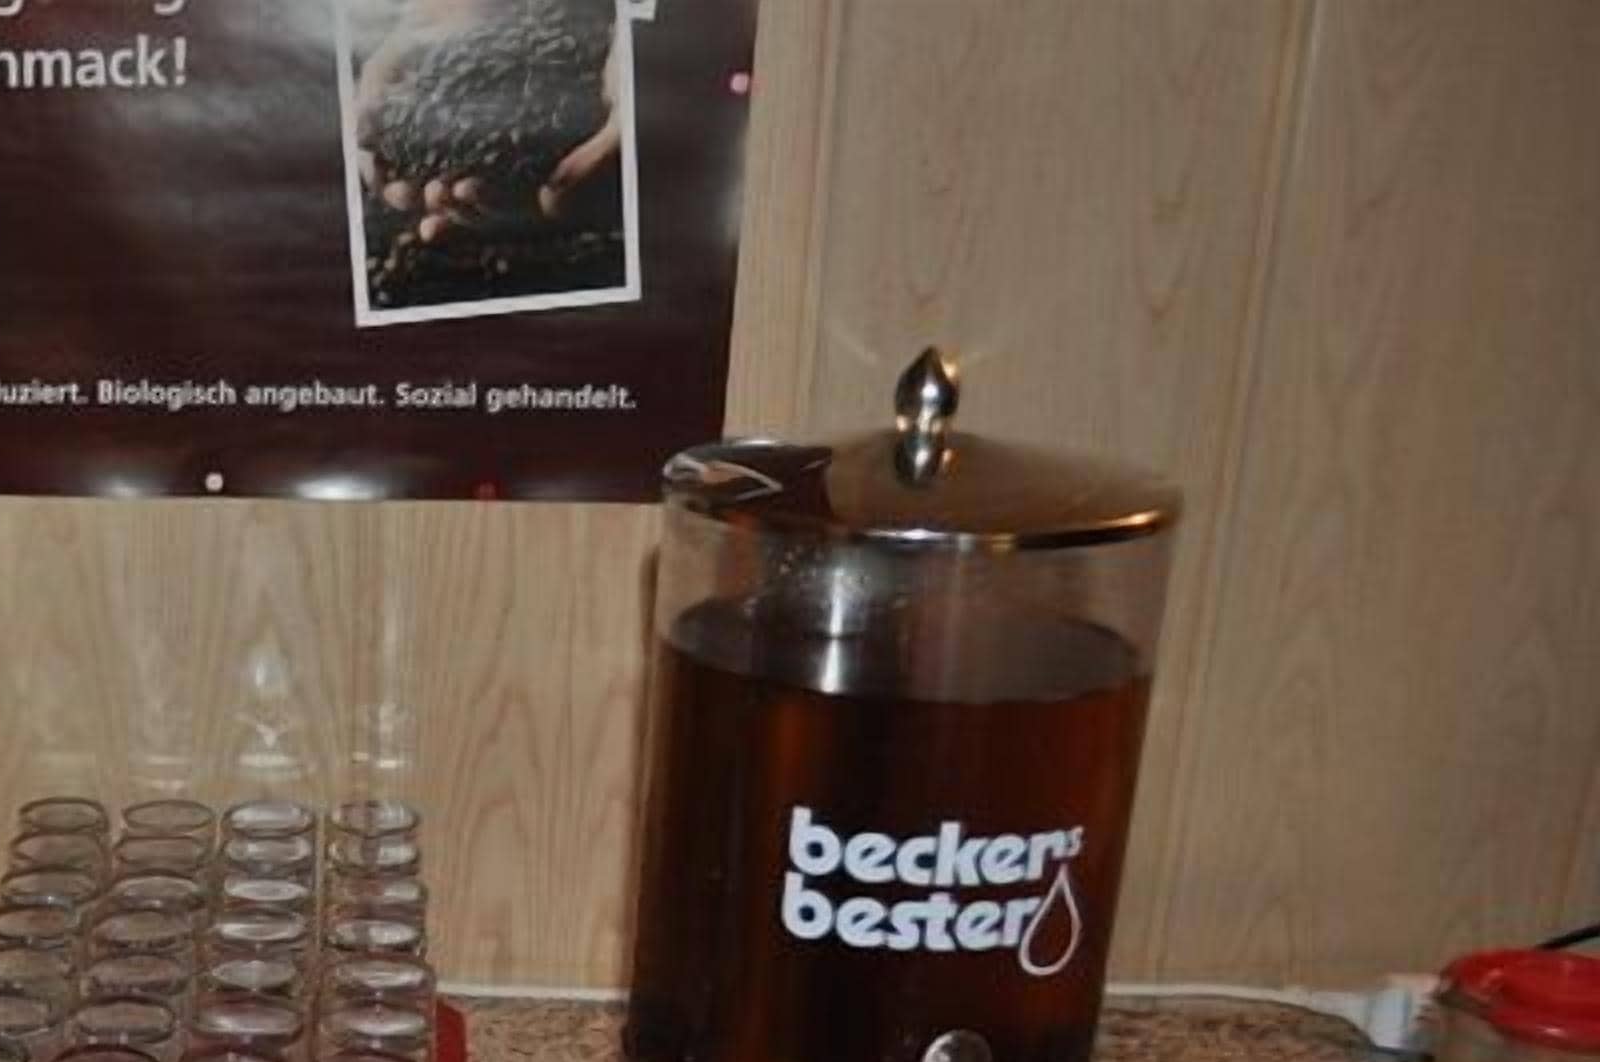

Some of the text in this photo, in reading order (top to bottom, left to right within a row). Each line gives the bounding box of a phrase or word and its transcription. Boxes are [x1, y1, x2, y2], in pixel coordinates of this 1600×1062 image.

[98, 379, 237, 411] Biologisch
[244, 379, 385, 412] angebaut.
[395, 381, 477, 407] Sozial
[486, 382, 637, 412] gehandelt.
[788, 806, 1083, 887] beckers
[781, 871, 1040, 951] bester
